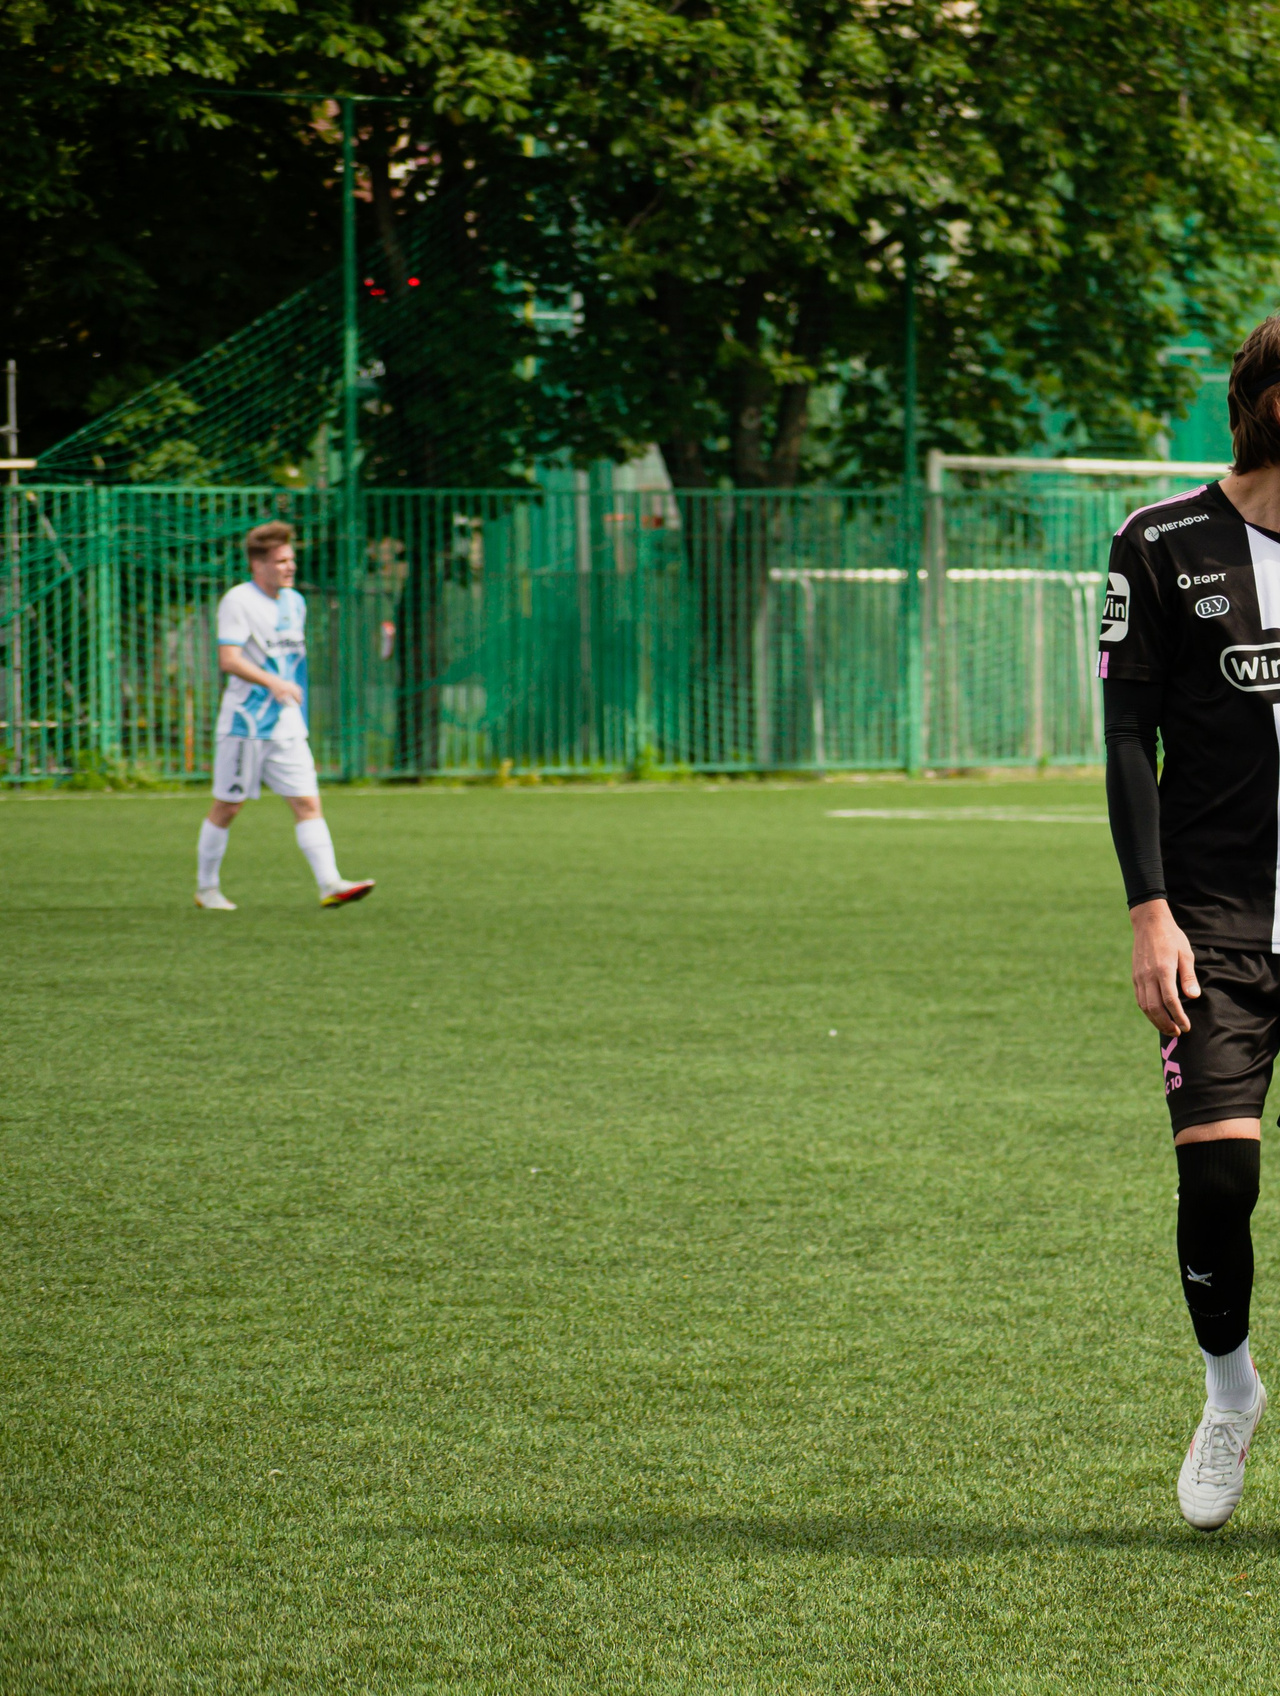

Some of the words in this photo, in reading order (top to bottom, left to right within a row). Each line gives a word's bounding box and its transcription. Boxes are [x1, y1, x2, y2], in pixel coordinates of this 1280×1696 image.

[1157, 513, 1210, 533] МЕГАФОН
[1193, 573, 1226, 585] EQPT
[1170, 1074, 1183, 1091] 10
